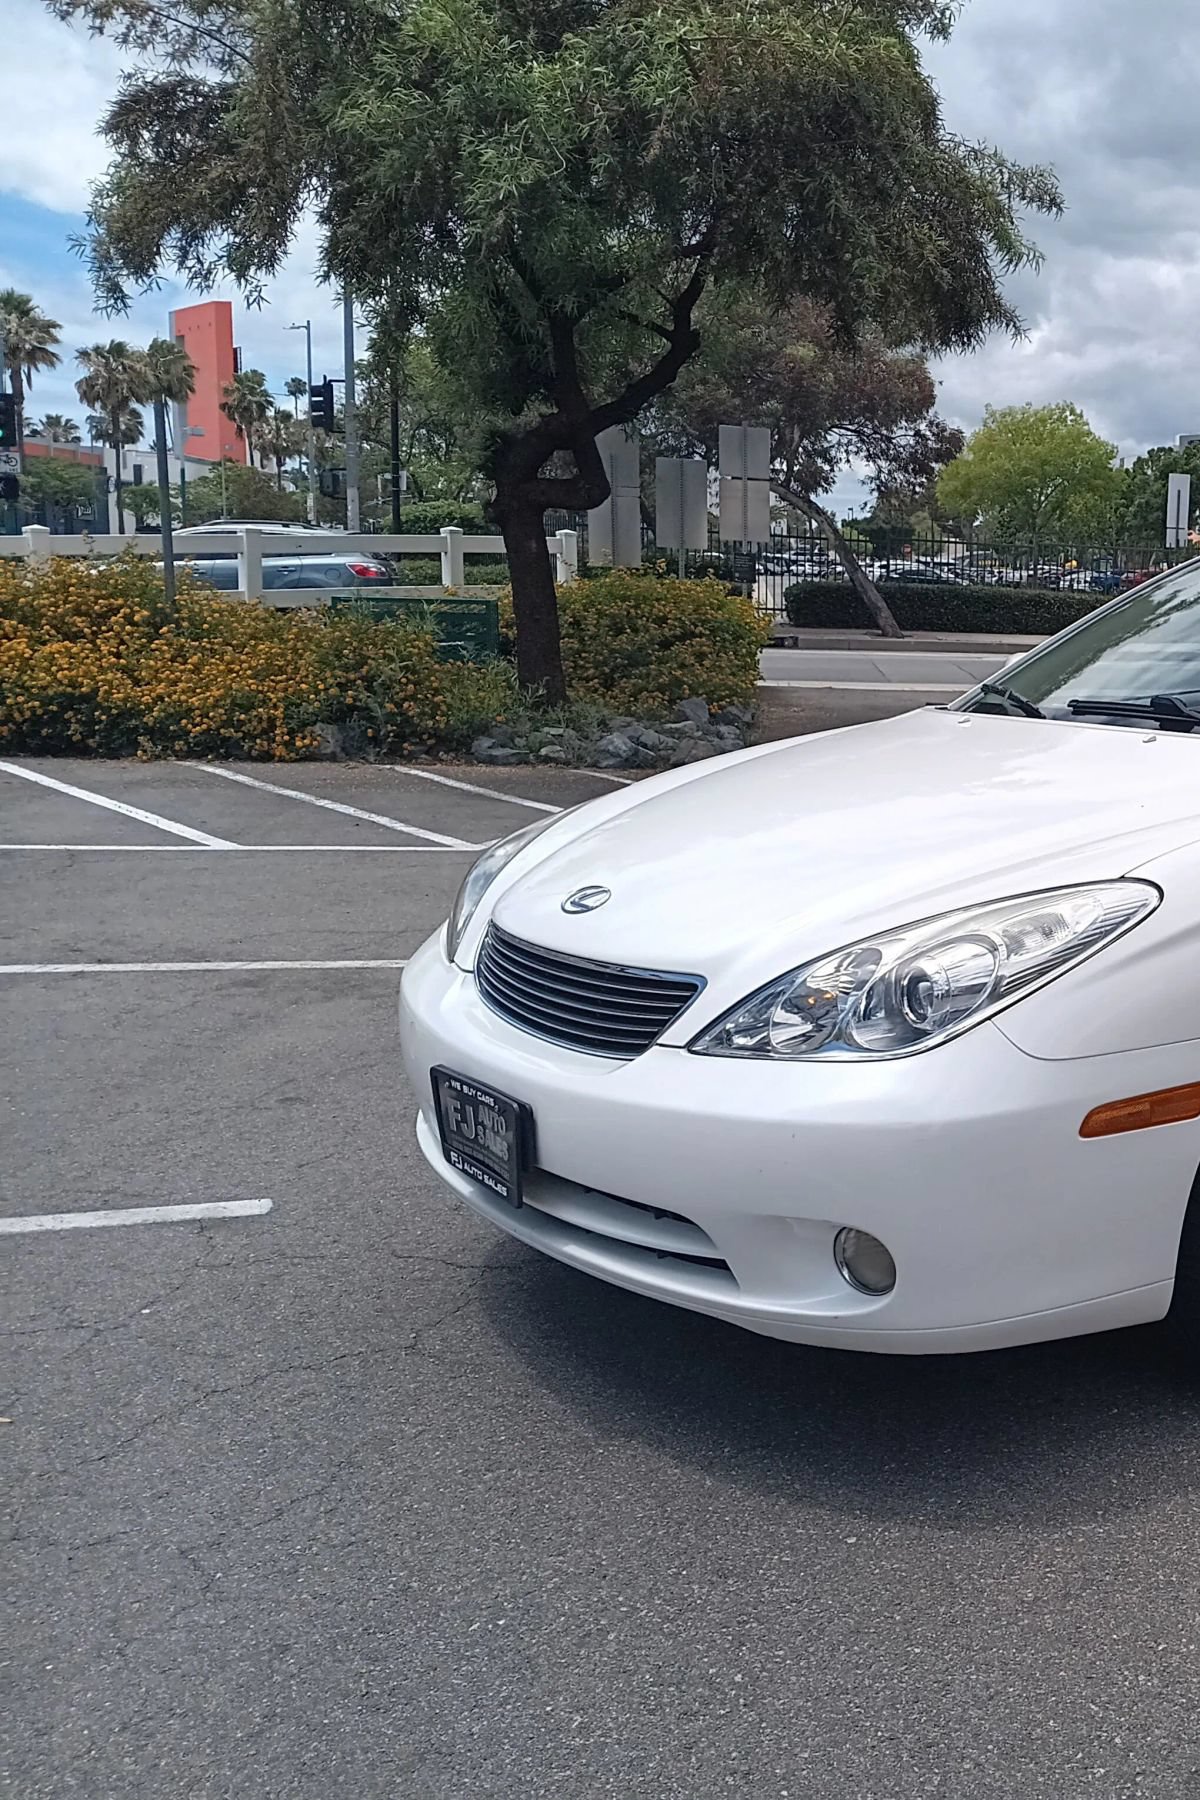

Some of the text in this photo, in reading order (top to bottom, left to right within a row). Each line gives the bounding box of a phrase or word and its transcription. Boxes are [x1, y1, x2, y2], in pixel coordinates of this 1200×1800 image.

[450, 1079, 494, 1107] WE BUY CARS
[446, 1096, 475, 1139] FJ
[479, 1104, 506, 1136] AUTO
[477, 1125, 508, 1161] SALES
[450, 1151, 463, 1170] FJ
[464, 1162, 483, 1180] AUTO
[484, 1175, 507, 1196] SALES
